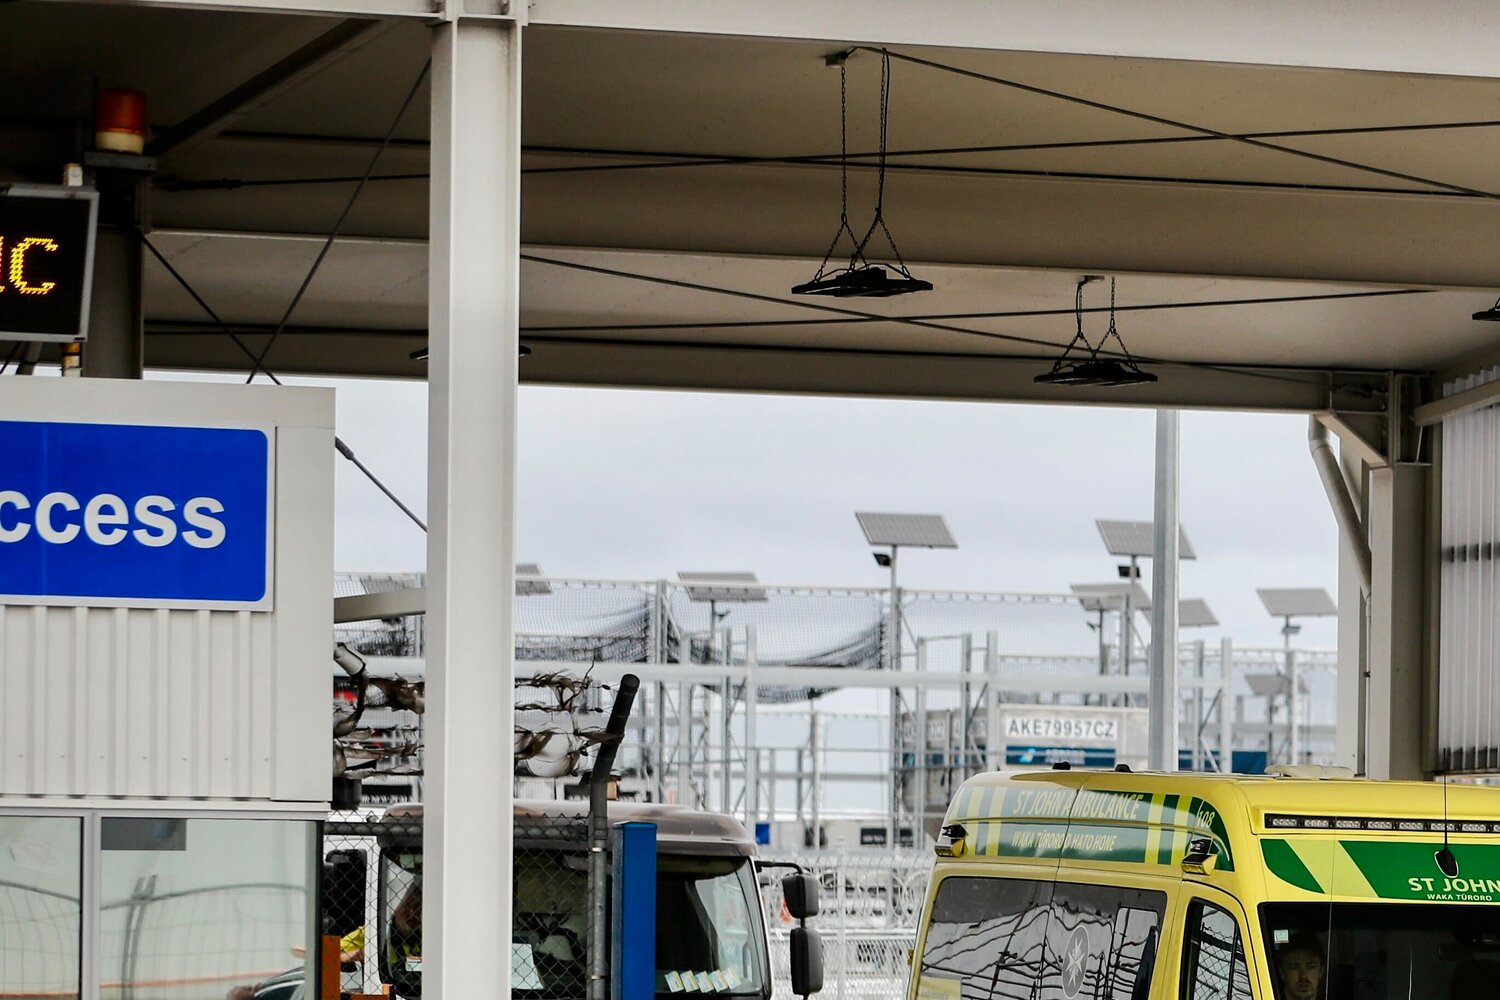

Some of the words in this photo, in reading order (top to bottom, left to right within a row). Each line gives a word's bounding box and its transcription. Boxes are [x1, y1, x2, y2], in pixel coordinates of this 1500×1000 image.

[0, 236, 58, 294] C
[0, 490, 226, 549] ccess
[1009, 719, 1114, 737] AKE79957CZ
[1013, 791, 1034, 815] ST
[1028, 791, 1066, 816] JOHN
[1061, 793, 1144, 819] AMBULANCE
[1408, 877, 1434, 892] ST
